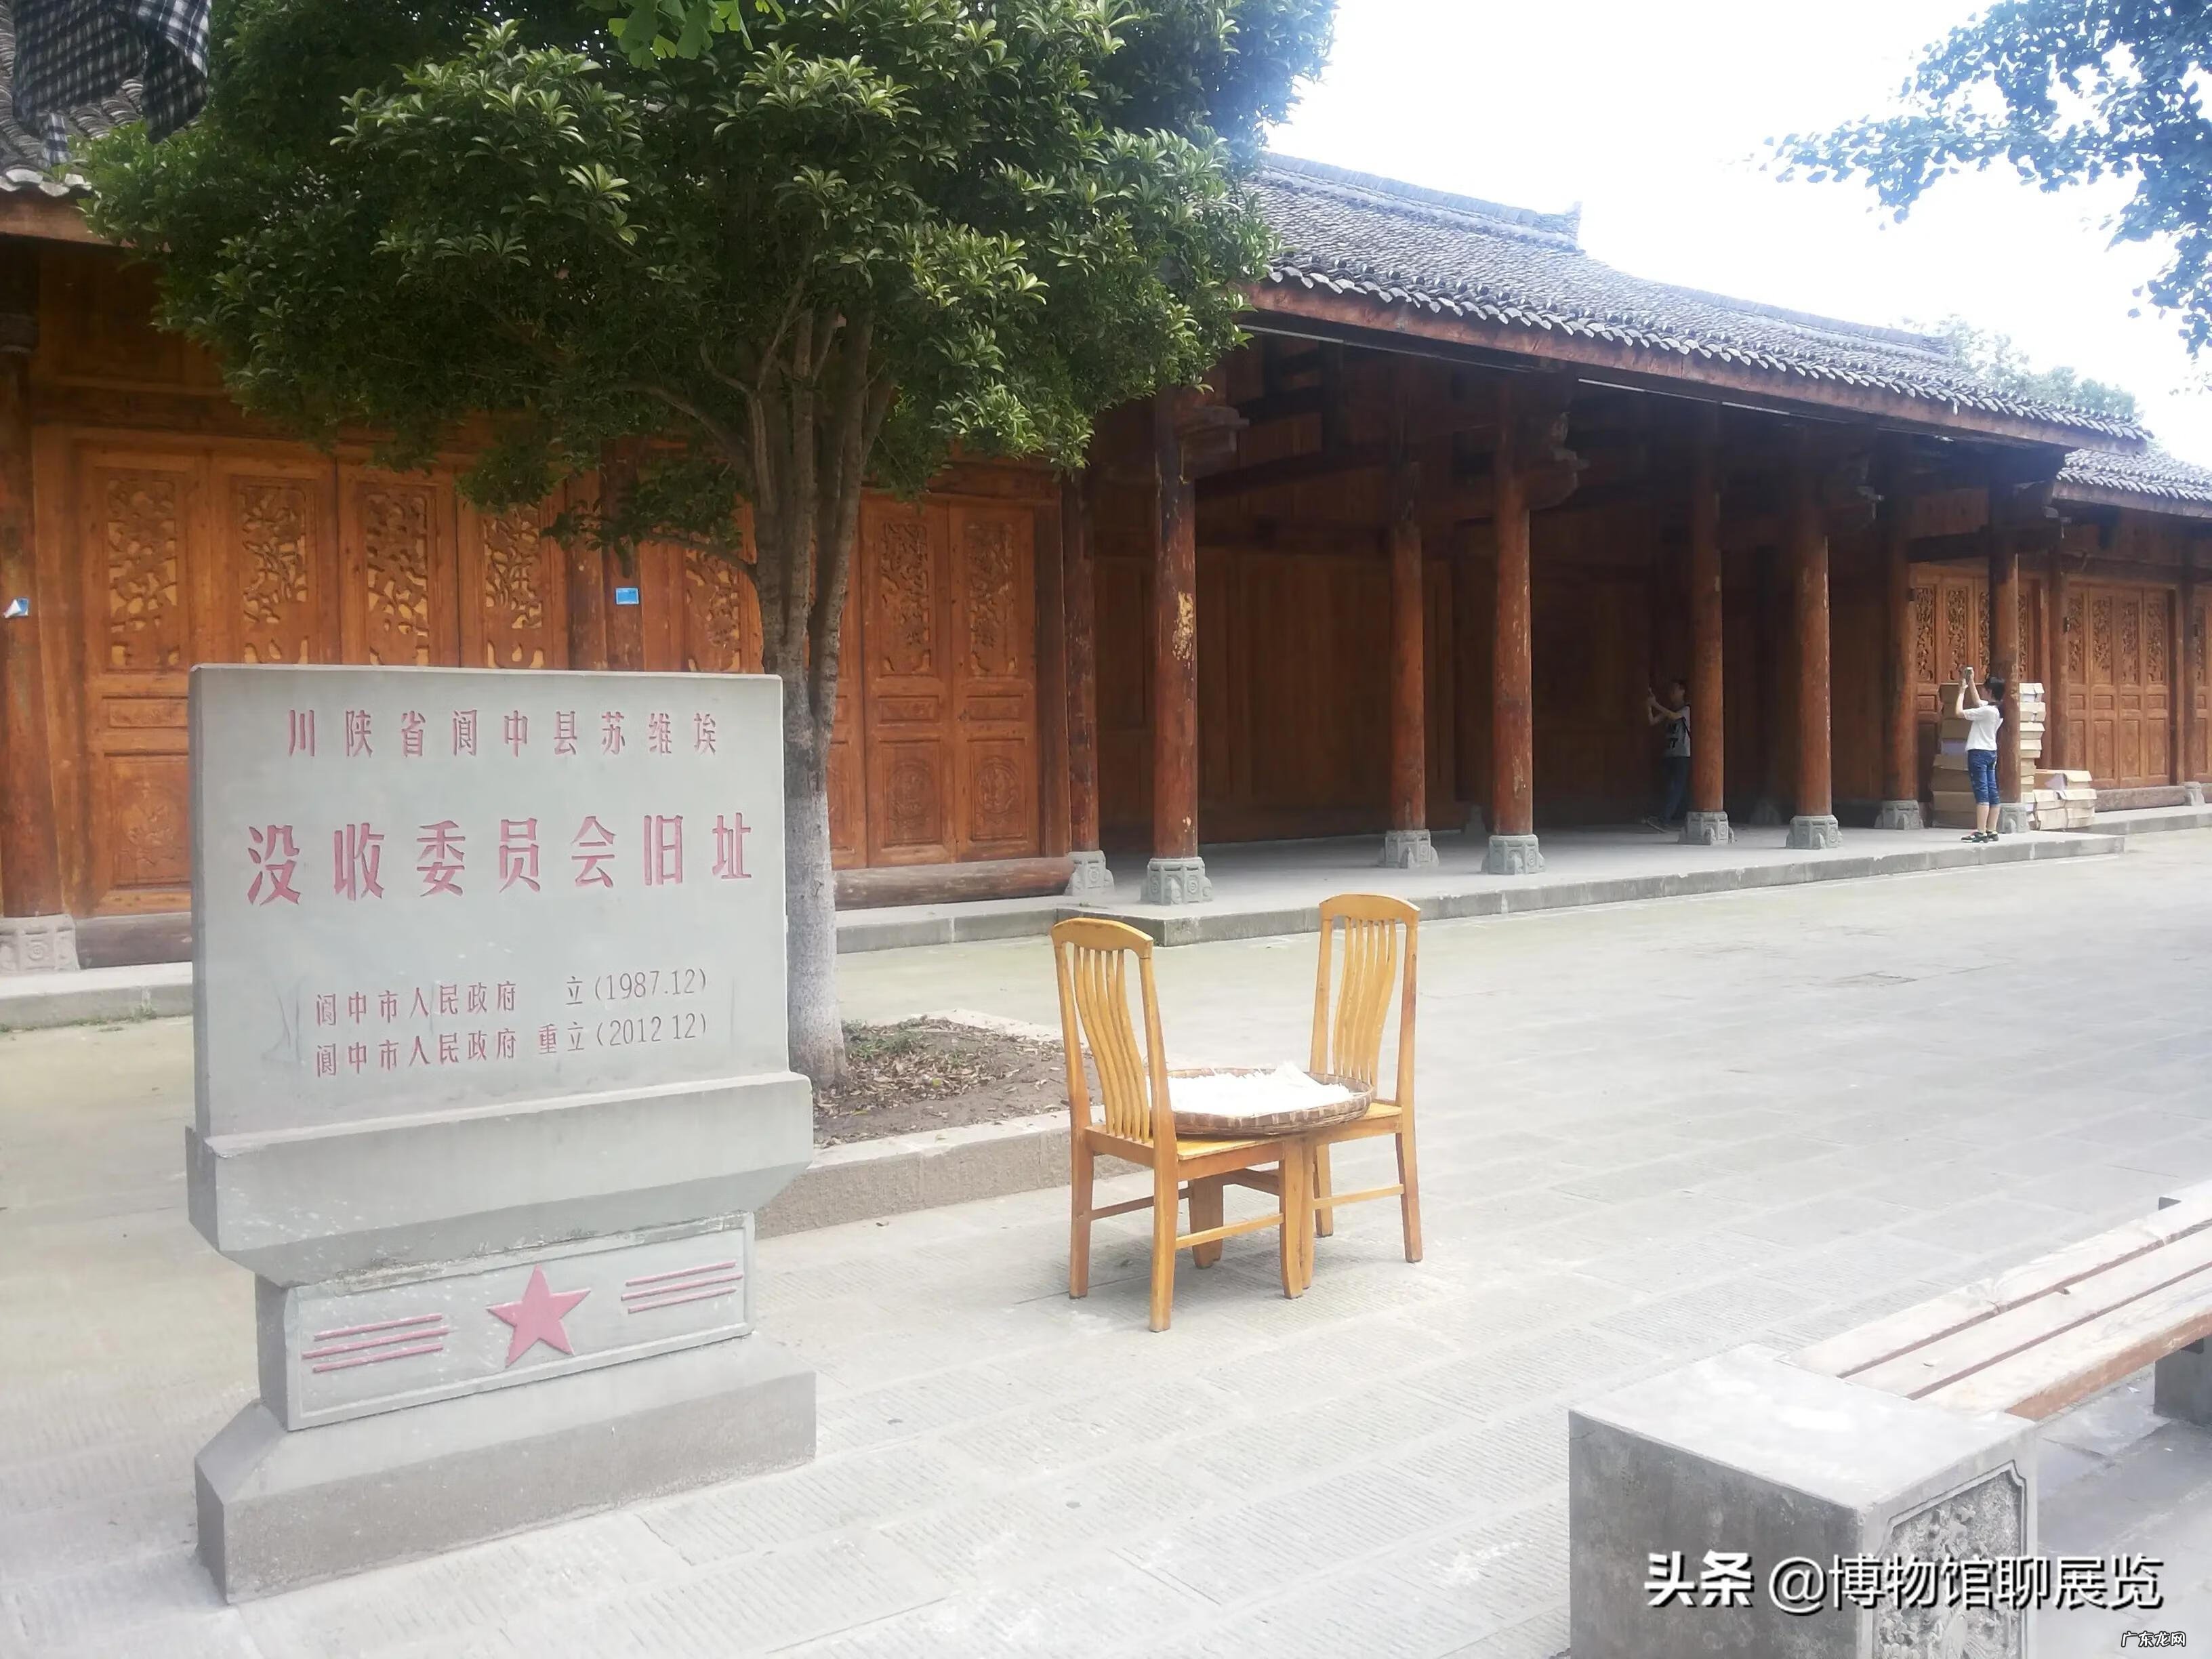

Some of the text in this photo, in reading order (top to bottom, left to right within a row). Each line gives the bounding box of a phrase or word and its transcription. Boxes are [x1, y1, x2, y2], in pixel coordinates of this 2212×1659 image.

[287, 709, 717, 758] 川陕省阆中县苏维埃
[246, 812, 753, 906] 没收委员会旧址
[316, 980, 516, 1027] 阆中市人民政府
[316, 1028, 516, 1078] 阆中市人民政府
